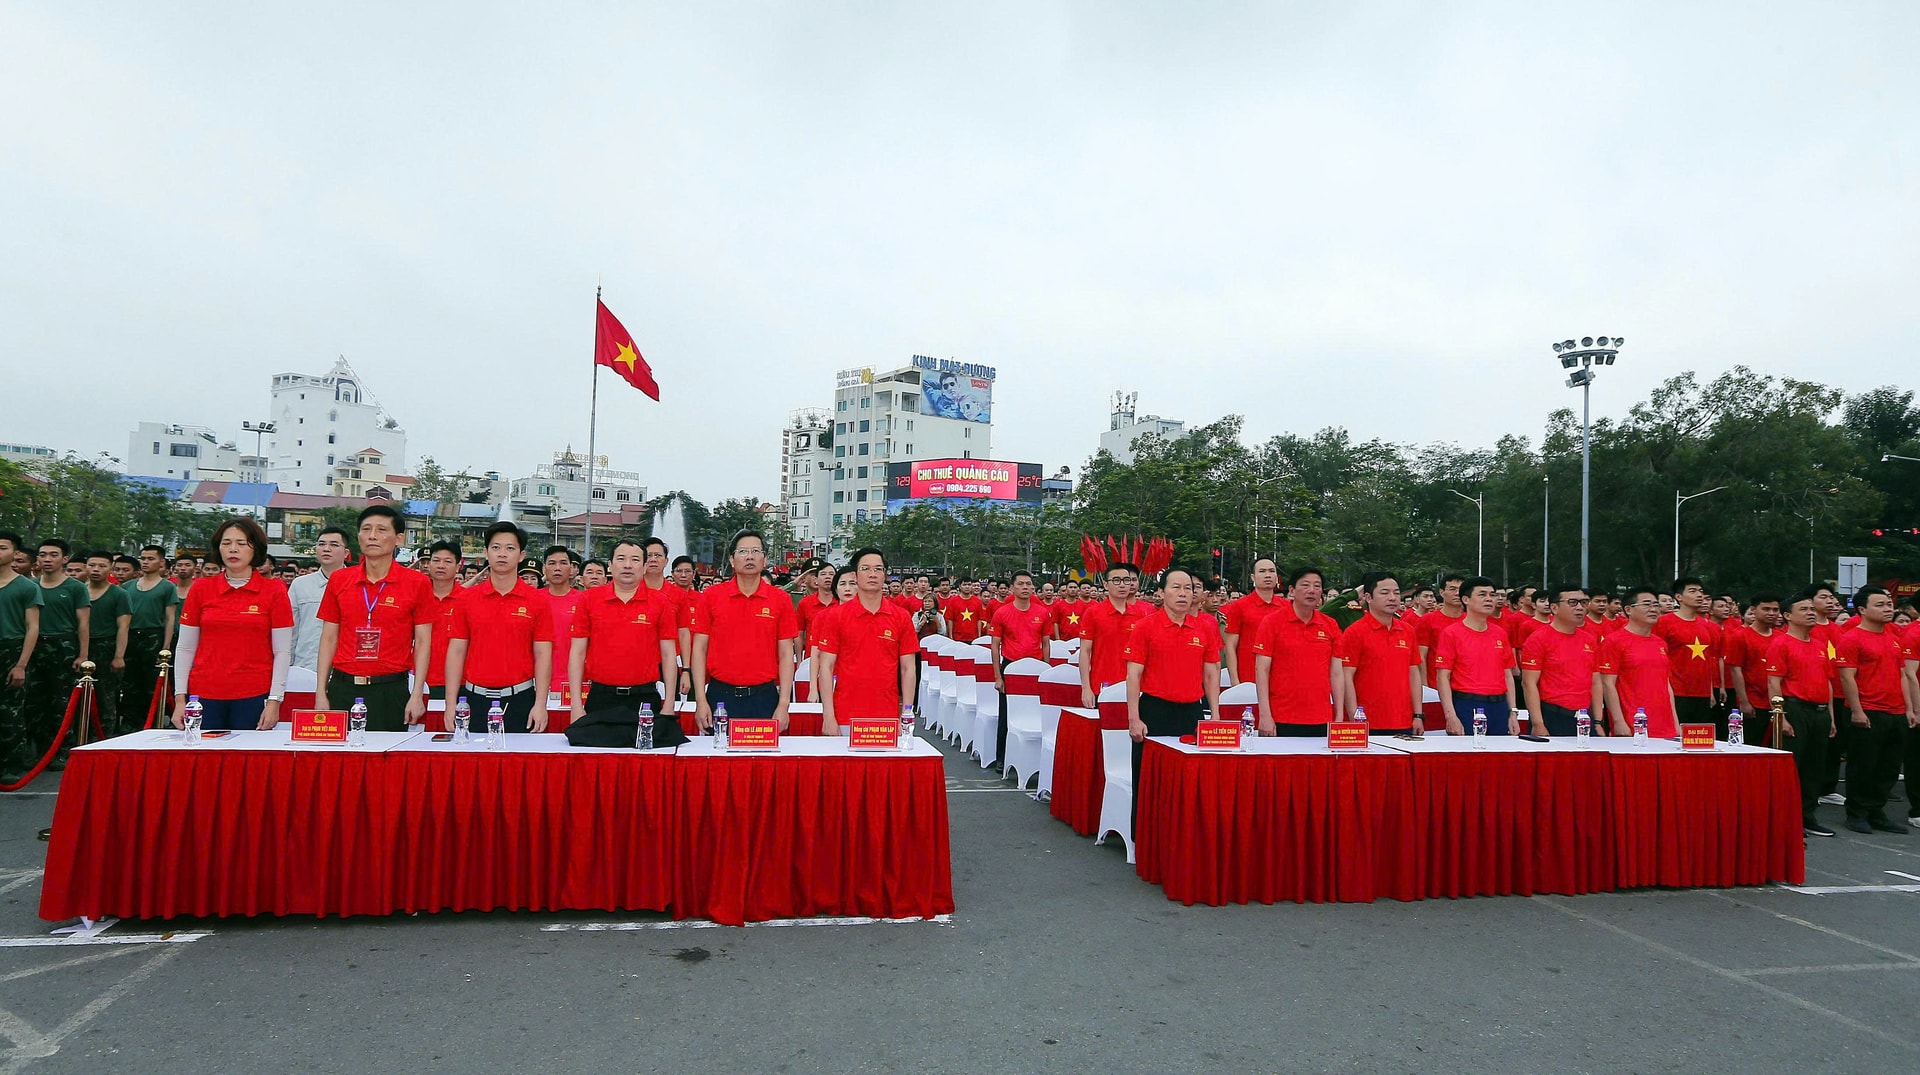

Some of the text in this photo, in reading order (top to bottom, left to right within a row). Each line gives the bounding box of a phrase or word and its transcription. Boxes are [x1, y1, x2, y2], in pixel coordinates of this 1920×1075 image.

[918, 464, 1009, 482] CHO THUÊ QUẢNG CÁO
